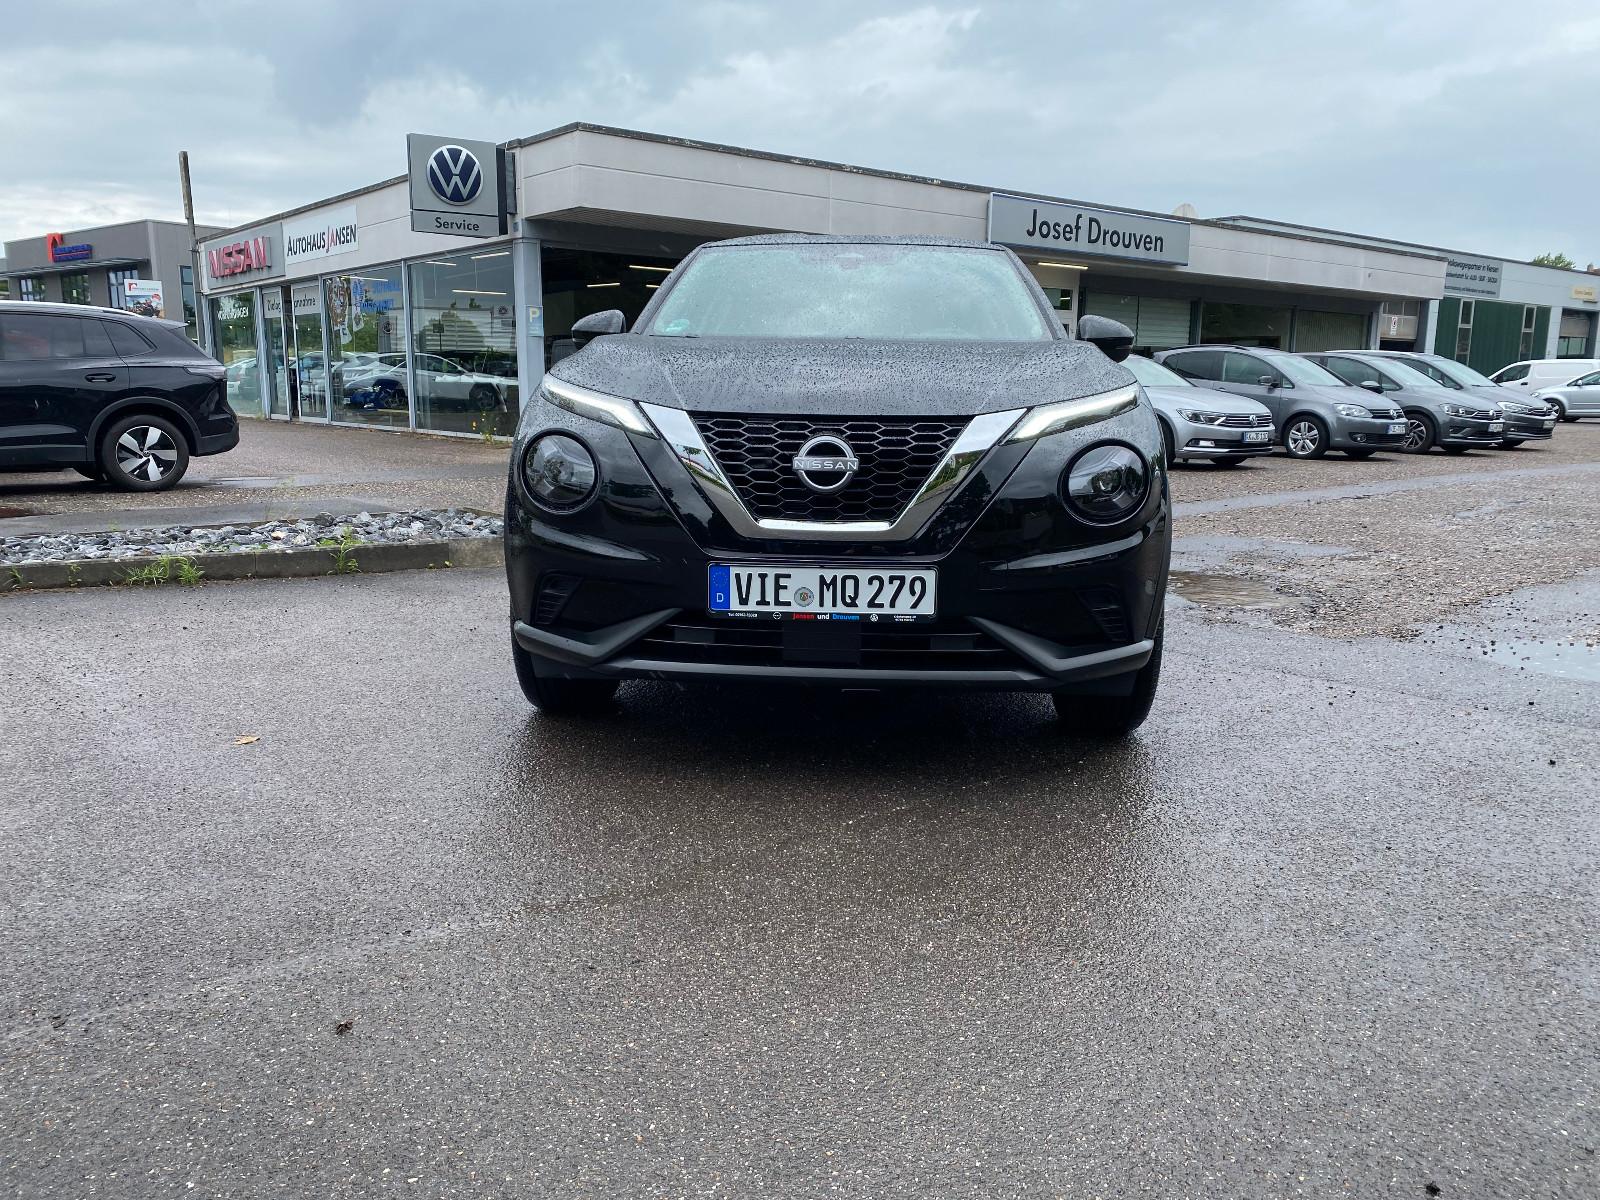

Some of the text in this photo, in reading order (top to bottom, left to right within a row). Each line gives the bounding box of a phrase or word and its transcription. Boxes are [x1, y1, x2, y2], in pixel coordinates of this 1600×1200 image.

[434, 216, 480, 232] Service
[1026, 208, 1164, 253] Josef Drouven
[287, 223, 357, 257] AUTOHAUS JANSEN
[208, 236, 270, 279] NISSAN
[529, 307, 540, 323] P
[794, 460, 857, 470] NISSAN
[716, 592, 724, 603] D
[734, 572, 792, 607] VIE
[792, 612, 860, 621] Jansen und Drouven
